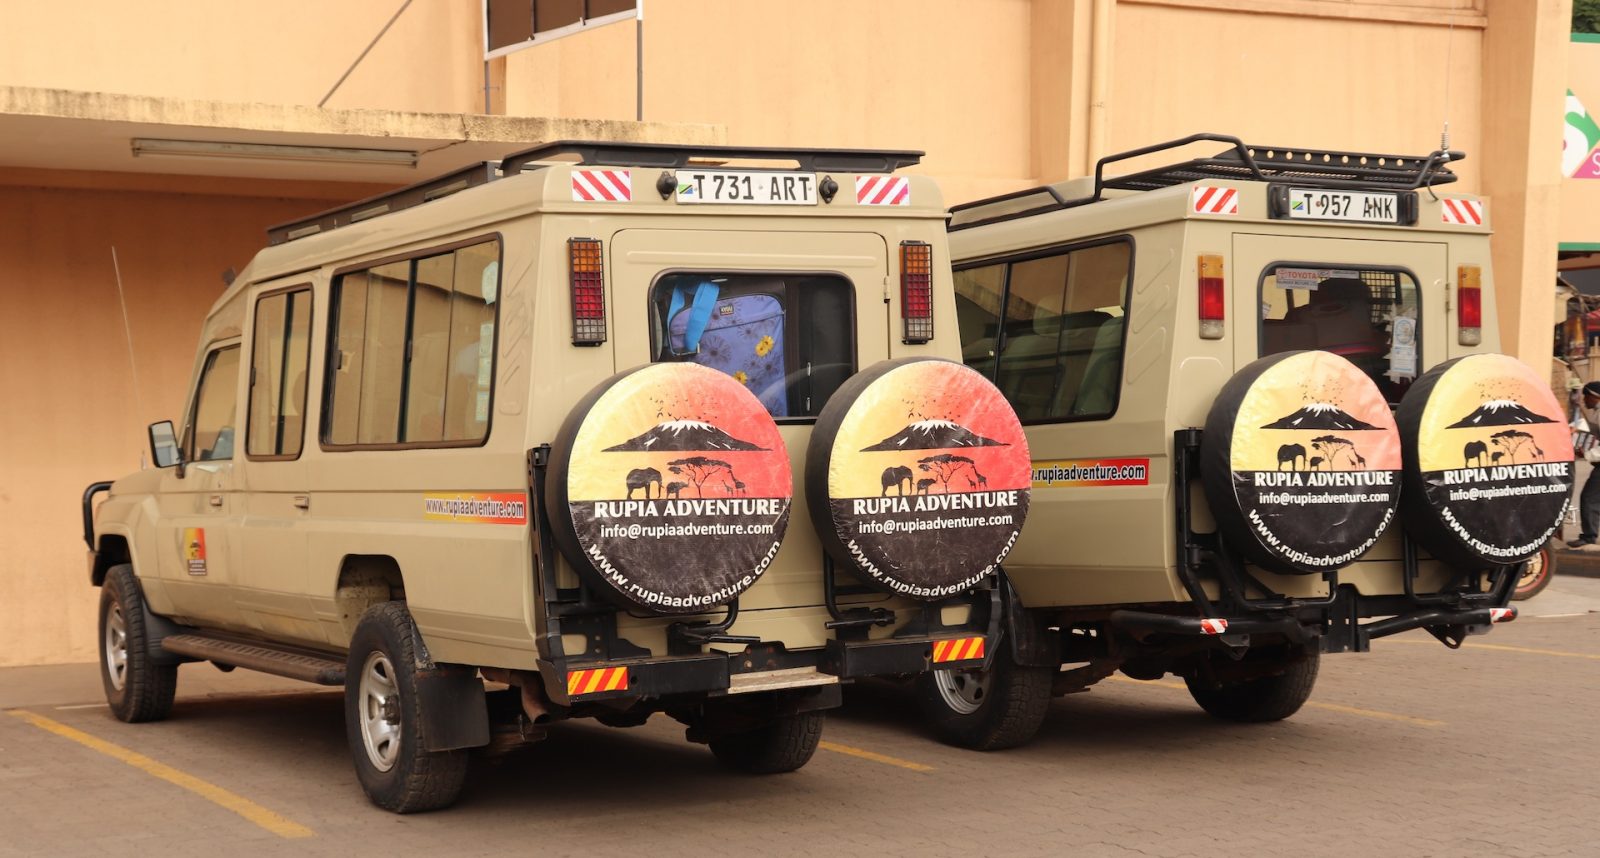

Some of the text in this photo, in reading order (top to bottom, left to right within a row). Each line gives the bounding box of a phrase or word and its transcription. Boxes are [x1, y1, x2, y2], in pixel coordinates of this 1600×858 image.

[693, 174, 810, 201] T 731 ART
[1303, 193, 1393, 219] T 957 ANK
[1287, 271, 1317, 280] TOYOTA
[1031, 464, 1145, 484] .rupiaadventure.com
[1254, 471, 1394, 487] RUPIA ADVENTURE
[1443, 462, 1569, 485] RUPIA ADVENTURE
[853, 491, 1018, 515] RUPIA ADVENTURE
[1259, 492, 1389, 507] info@rupiaadventure.com
[1450, 483, 1567, 501] info@rupiaadventure.com
[425, 496, 524, 519] www.rupiaadventure.com
[594, 499, 780, 518] RUPIA ADVENTURE
[600, 522, 774, 540] info@rupiaadventure.com
[859, 515, 1013, 535] info@rupiaadventure.com
[1441, 498, 1570, 557] www.rupiaadventure.com
[1249, 508, 1394, 567] www.rupiaadventure.com
[589, 540, 781, 608] www.rupiaadventure.com
[848, 530, 1019, 597] www.rupiaadventure.com
